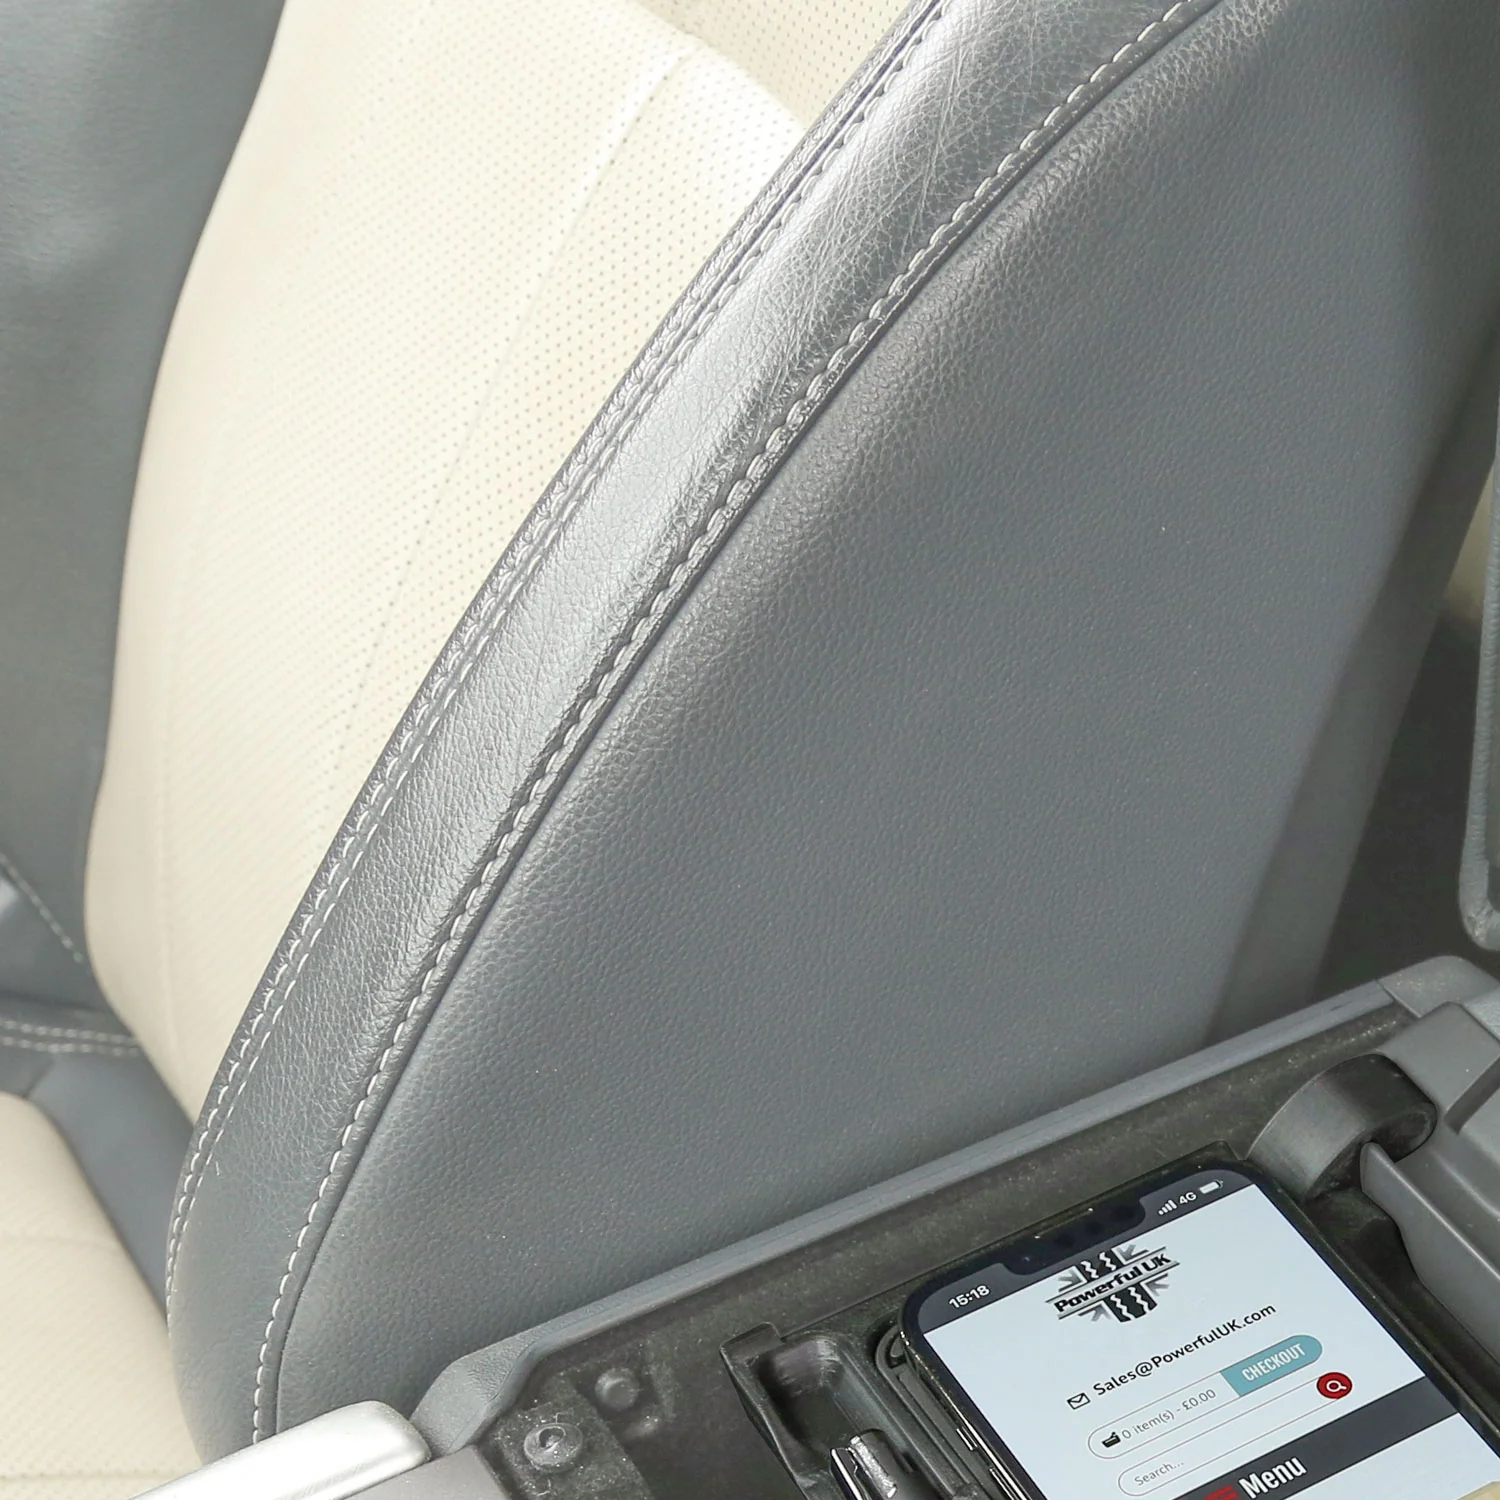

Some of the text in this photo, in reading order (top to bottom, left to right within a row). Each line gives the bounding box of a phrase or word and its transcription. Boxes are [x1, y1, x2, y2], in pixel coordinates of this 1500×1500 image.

[1178, 1190, 1198, 1207] 4G
[948, 1284, 991, 1310] 15:18
[1054, 1253, 1172, 1312] Powerful UK
[1092, 1304, 1277, 1396] Sales@PowerfulUK.com
[1241, 1342, 1307, 1382] CHECKOUT
[1134, 1409, 1175, 1435] item(s)
[1182, 1388, 1217, 1411] £0.00
[1238, 1456, 1308, 1500] Menu
